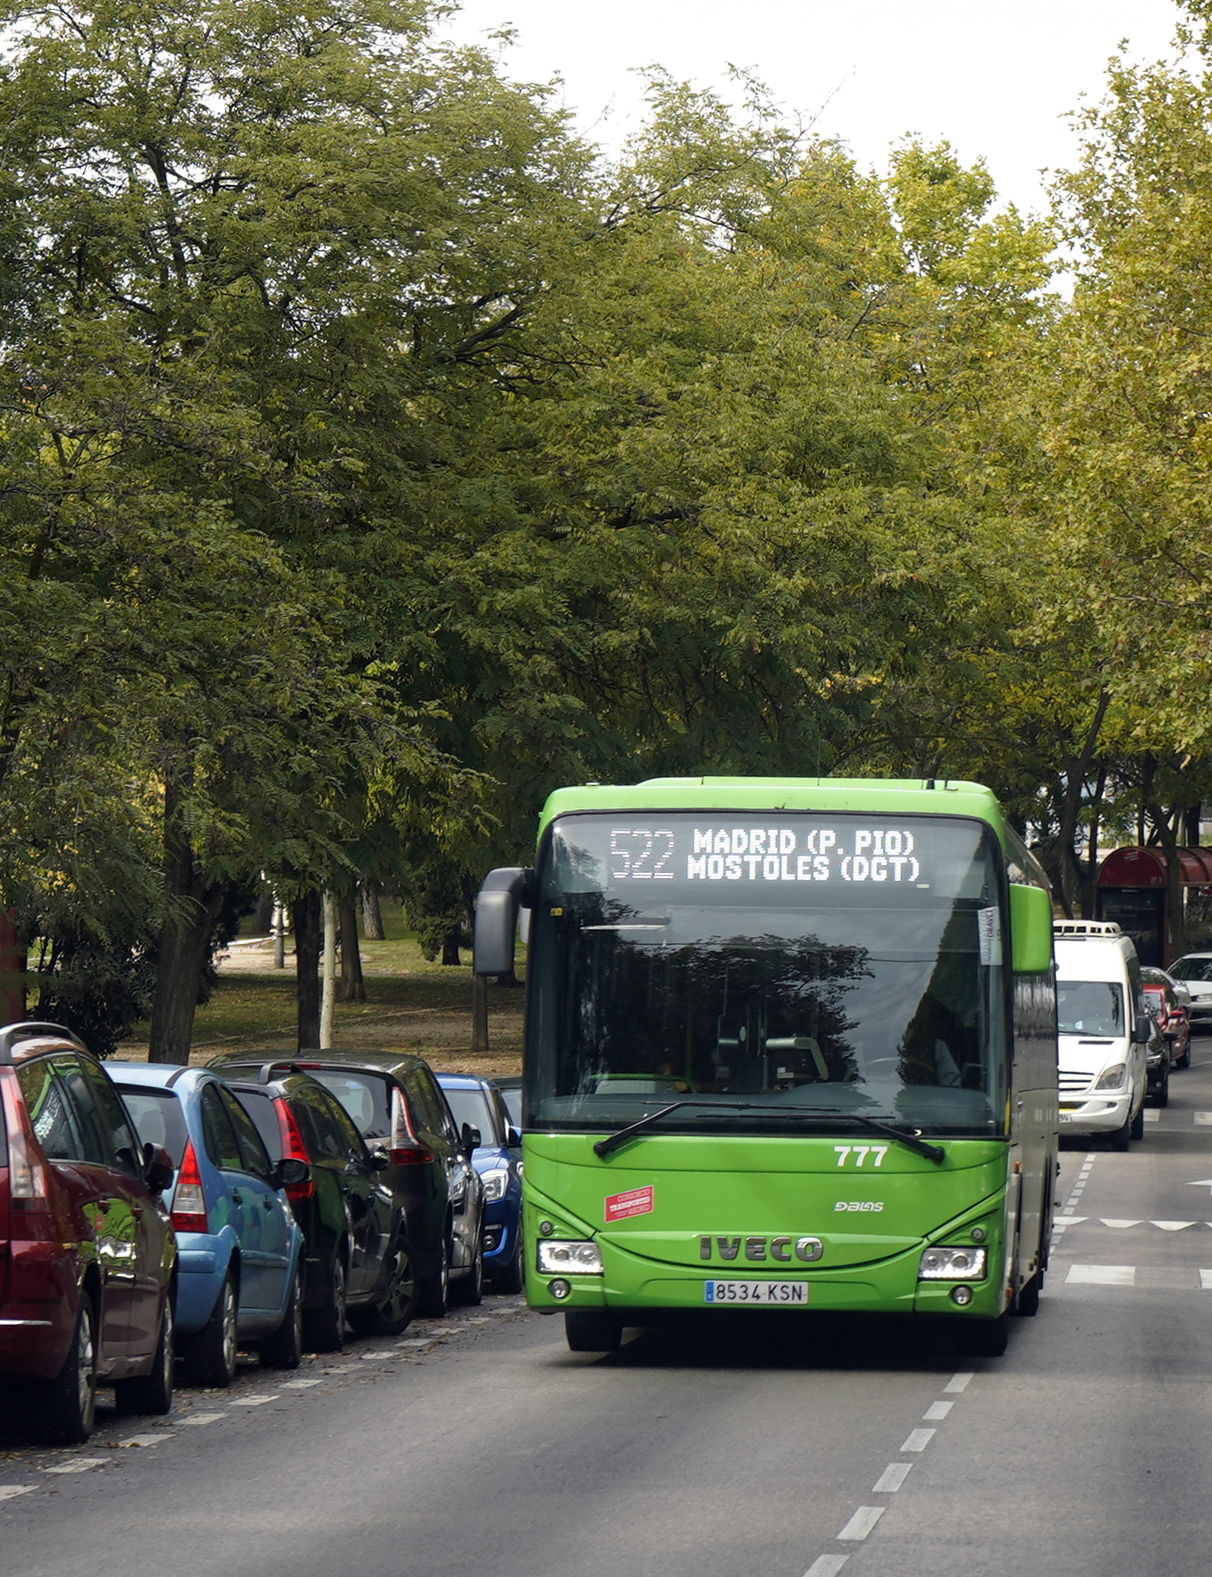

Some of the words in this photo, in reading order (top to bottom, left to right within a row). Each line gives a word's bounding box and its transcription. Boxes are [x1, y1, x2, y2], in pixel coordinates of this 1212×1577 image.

[610, 828, 674, 879] 522
[693, 829, 796, 854] MADRID
[807, 830, 844, 855] (P.
[855, 830, 914, 855] PIO)
[687, 855, 830, 881] MOSTOLES
[841, 856, 920, 882] (DGT)
[834, 1146, 888, 1167] 777
[700, 1235, 824, 1262] IVECO
[716, 1284, 761, 1301] 8534
[768, 1285, 802, 1301] KSN
